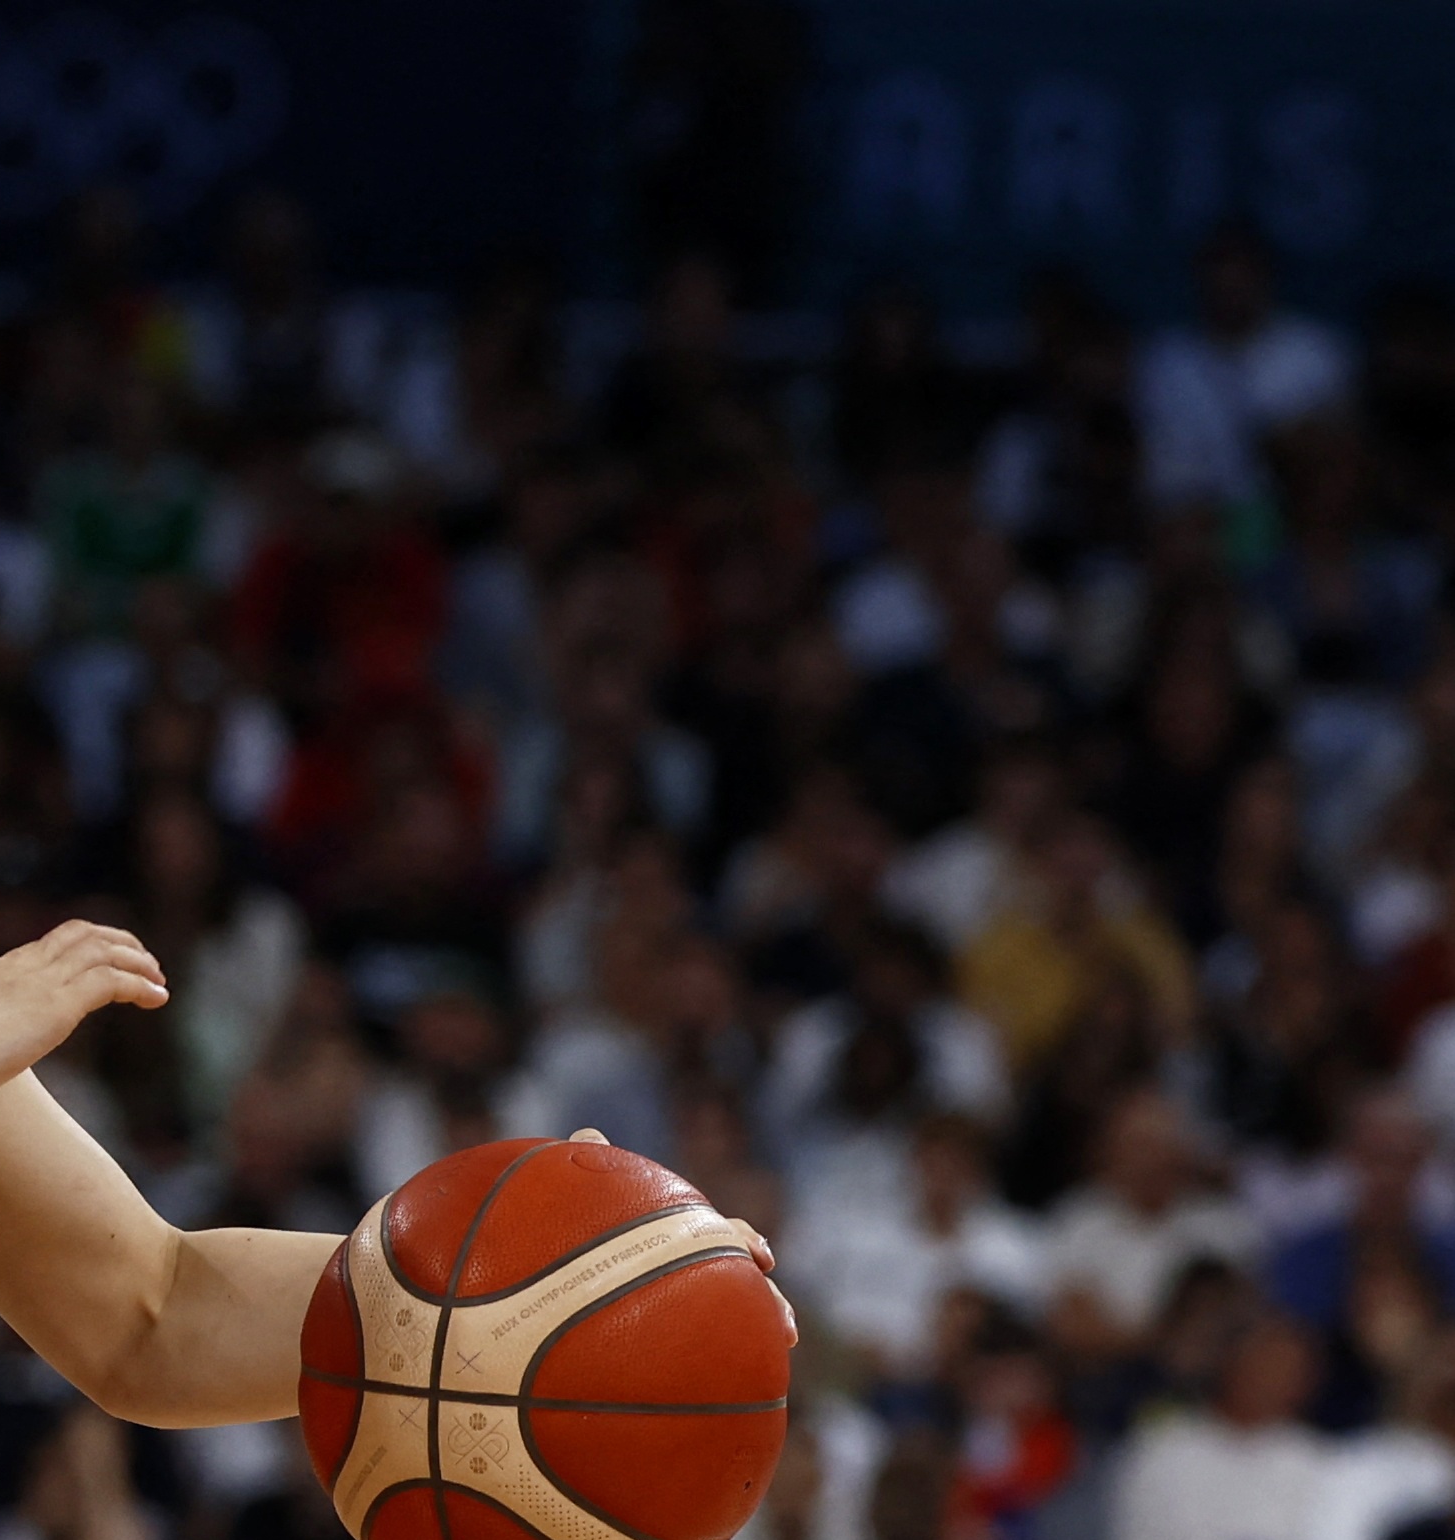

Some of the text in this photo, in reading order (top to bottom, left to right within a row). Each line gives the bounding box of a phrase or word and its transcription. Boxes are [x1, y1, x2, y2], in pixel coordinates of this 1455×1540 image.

[844, 66, 1375, 250] ARIS
[491, 1316, 520, 1340] JEUX
[520, 1268, 596, 1319] OLYMPIQUES
[611, 1243, 644, 1265] PARIS
